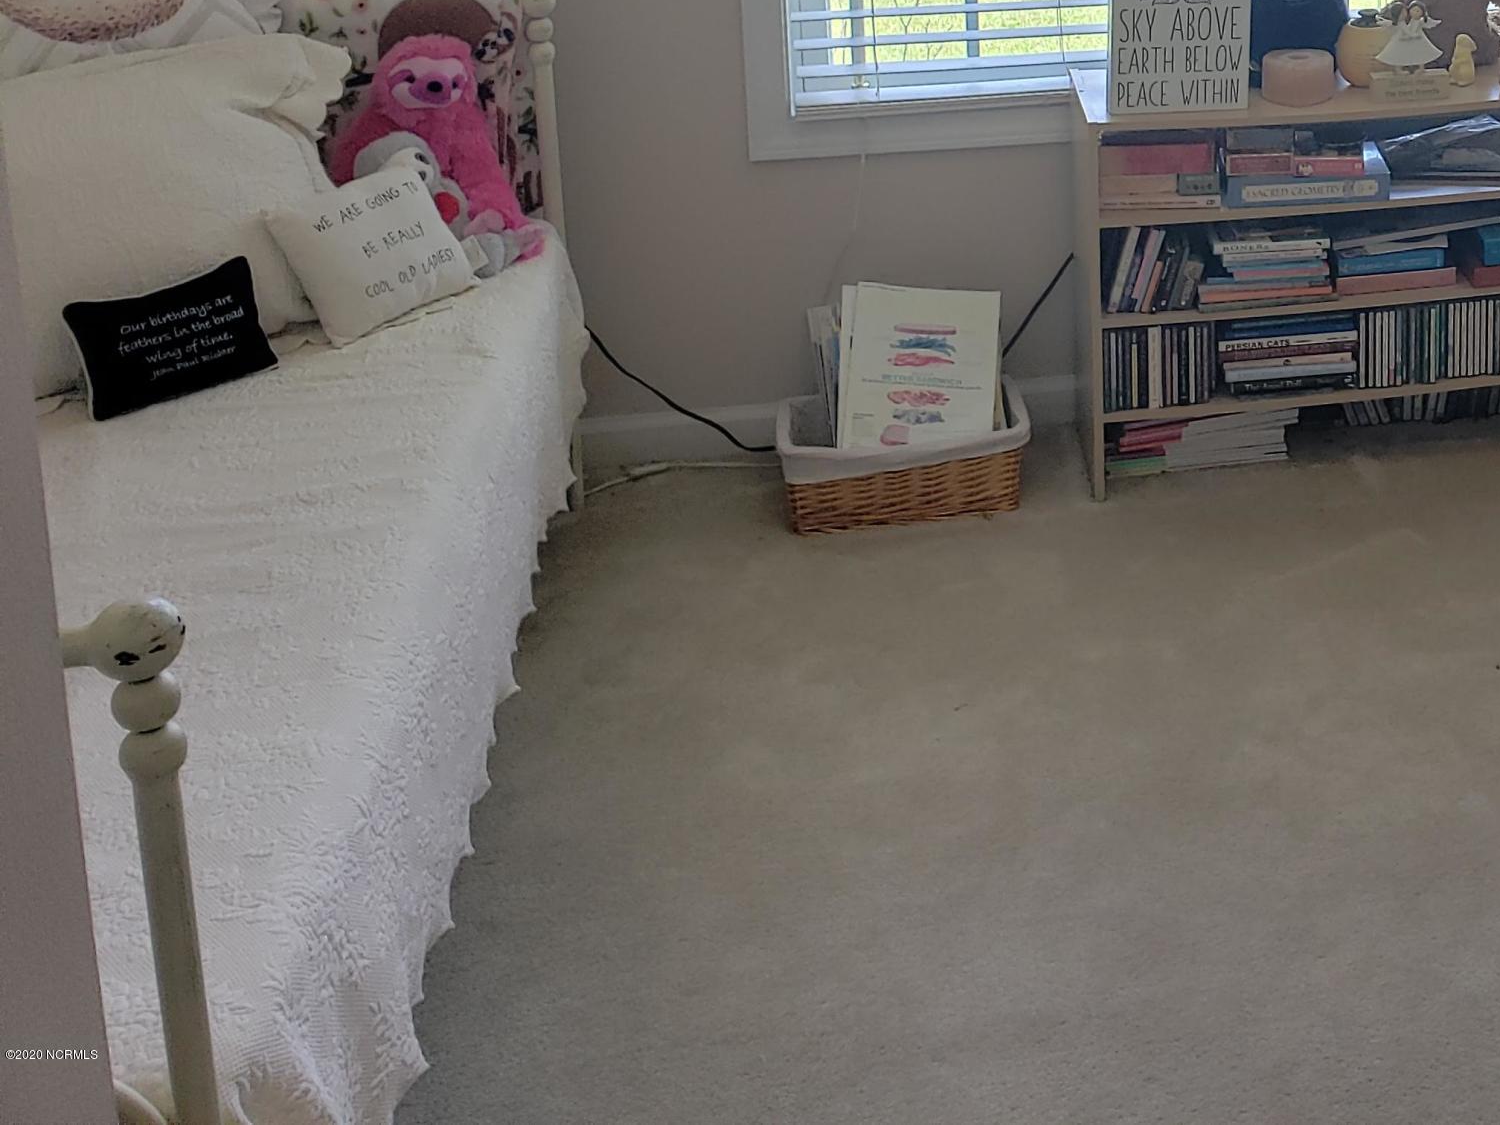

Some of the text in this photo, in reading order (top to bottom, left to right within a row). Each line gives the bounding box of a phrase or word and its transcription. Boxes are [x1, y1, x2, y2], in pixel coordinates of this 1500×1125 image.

[1119, 6, 1242, 43] SKY ABOVE
[1117, 44, 1243, 75] EARTH BELOW
[1117, 78, 1240, 108] PEACE WITHIN
[313, 181, 418, 233] WE ARE GOING TO
[1251, 187, 1289, 198] SACRED
[362, 221, 425, 259] BE REALLY
[365, 280, 395, 298] COOL
[399, 265, 416, 284] OLD
[120, 294, 233, 335] Our birthdays are
[118, 306, 244, 357] feathers in the broad
[145, 331, 233, 364] wing of time.
[1225, 339, 1290, 352] PERSIAN CATS
[176, 357, 199, 370] Paul
